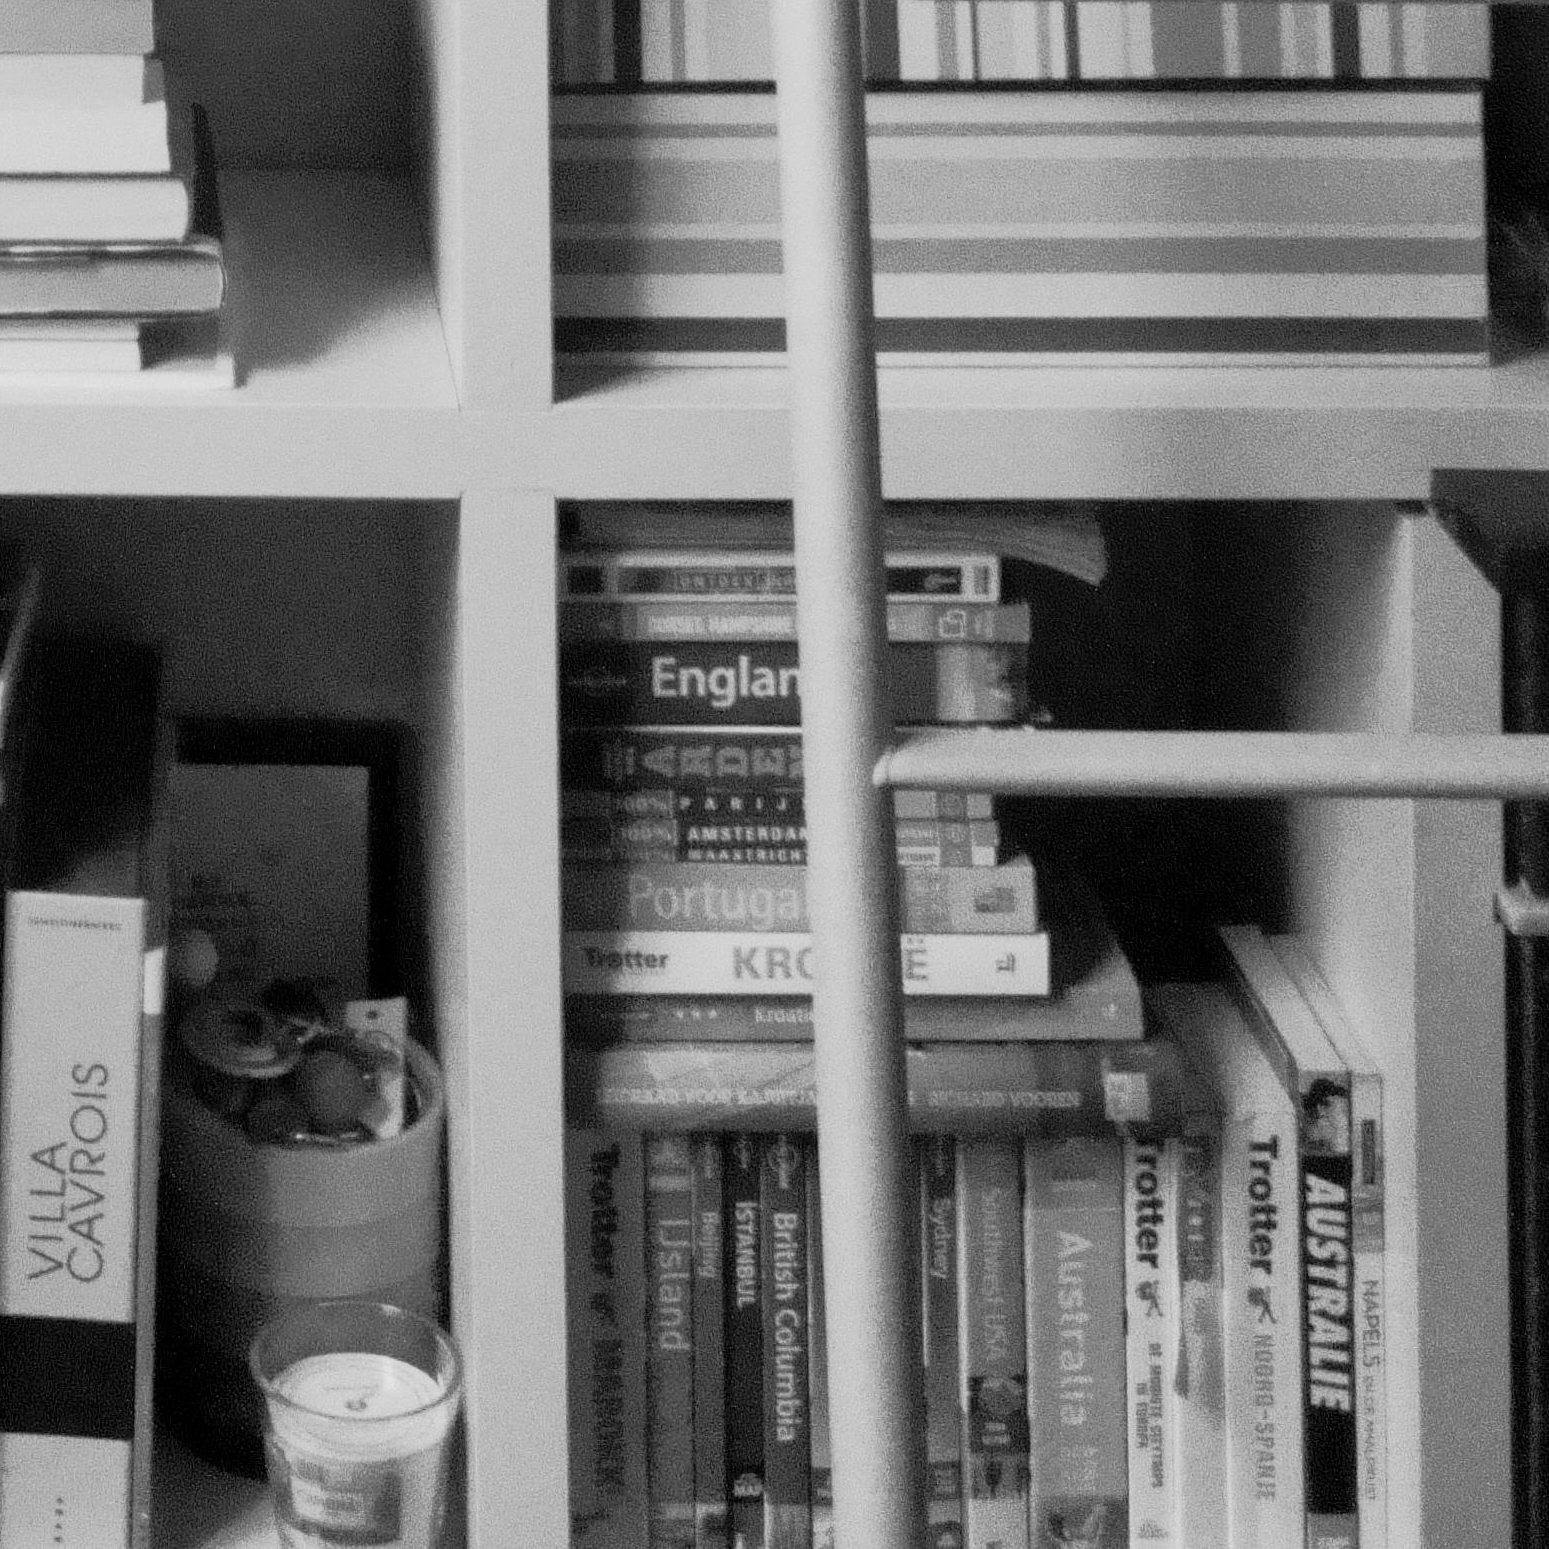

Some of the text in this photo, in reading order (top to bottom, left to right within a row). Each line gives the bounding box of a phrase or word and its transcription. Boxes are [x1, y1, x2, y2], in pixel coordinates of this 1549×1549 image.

[651, 655, 802, 710] Englan
[678, 795, 788, 812] PARIJ
[628, 872, 800, 931] Portuga
[582, 945, 670, 970] Trotter
[28, 1140, 70, 1280] VILLA
[66, 1060, 110, 1285] CAVROIS
[1135, 1135, 1166, 1270] Trotter
[698, 1210, 723, 1279] Beijing
[928, 1197, 953, 1281] Sydney
[772, 1211, 803, 1443] British Columbia
[982, 1313, 1009, 1361] USA
[1055, 1228, 1096, 1428] Australia
[1247, 1134, 1281, 1502] Trotter NOORD-SPANJE
[1304, 1172, 1352, 1412] AUSTRALIE
[1360, 1279, 1382, 1369] NAPELS
